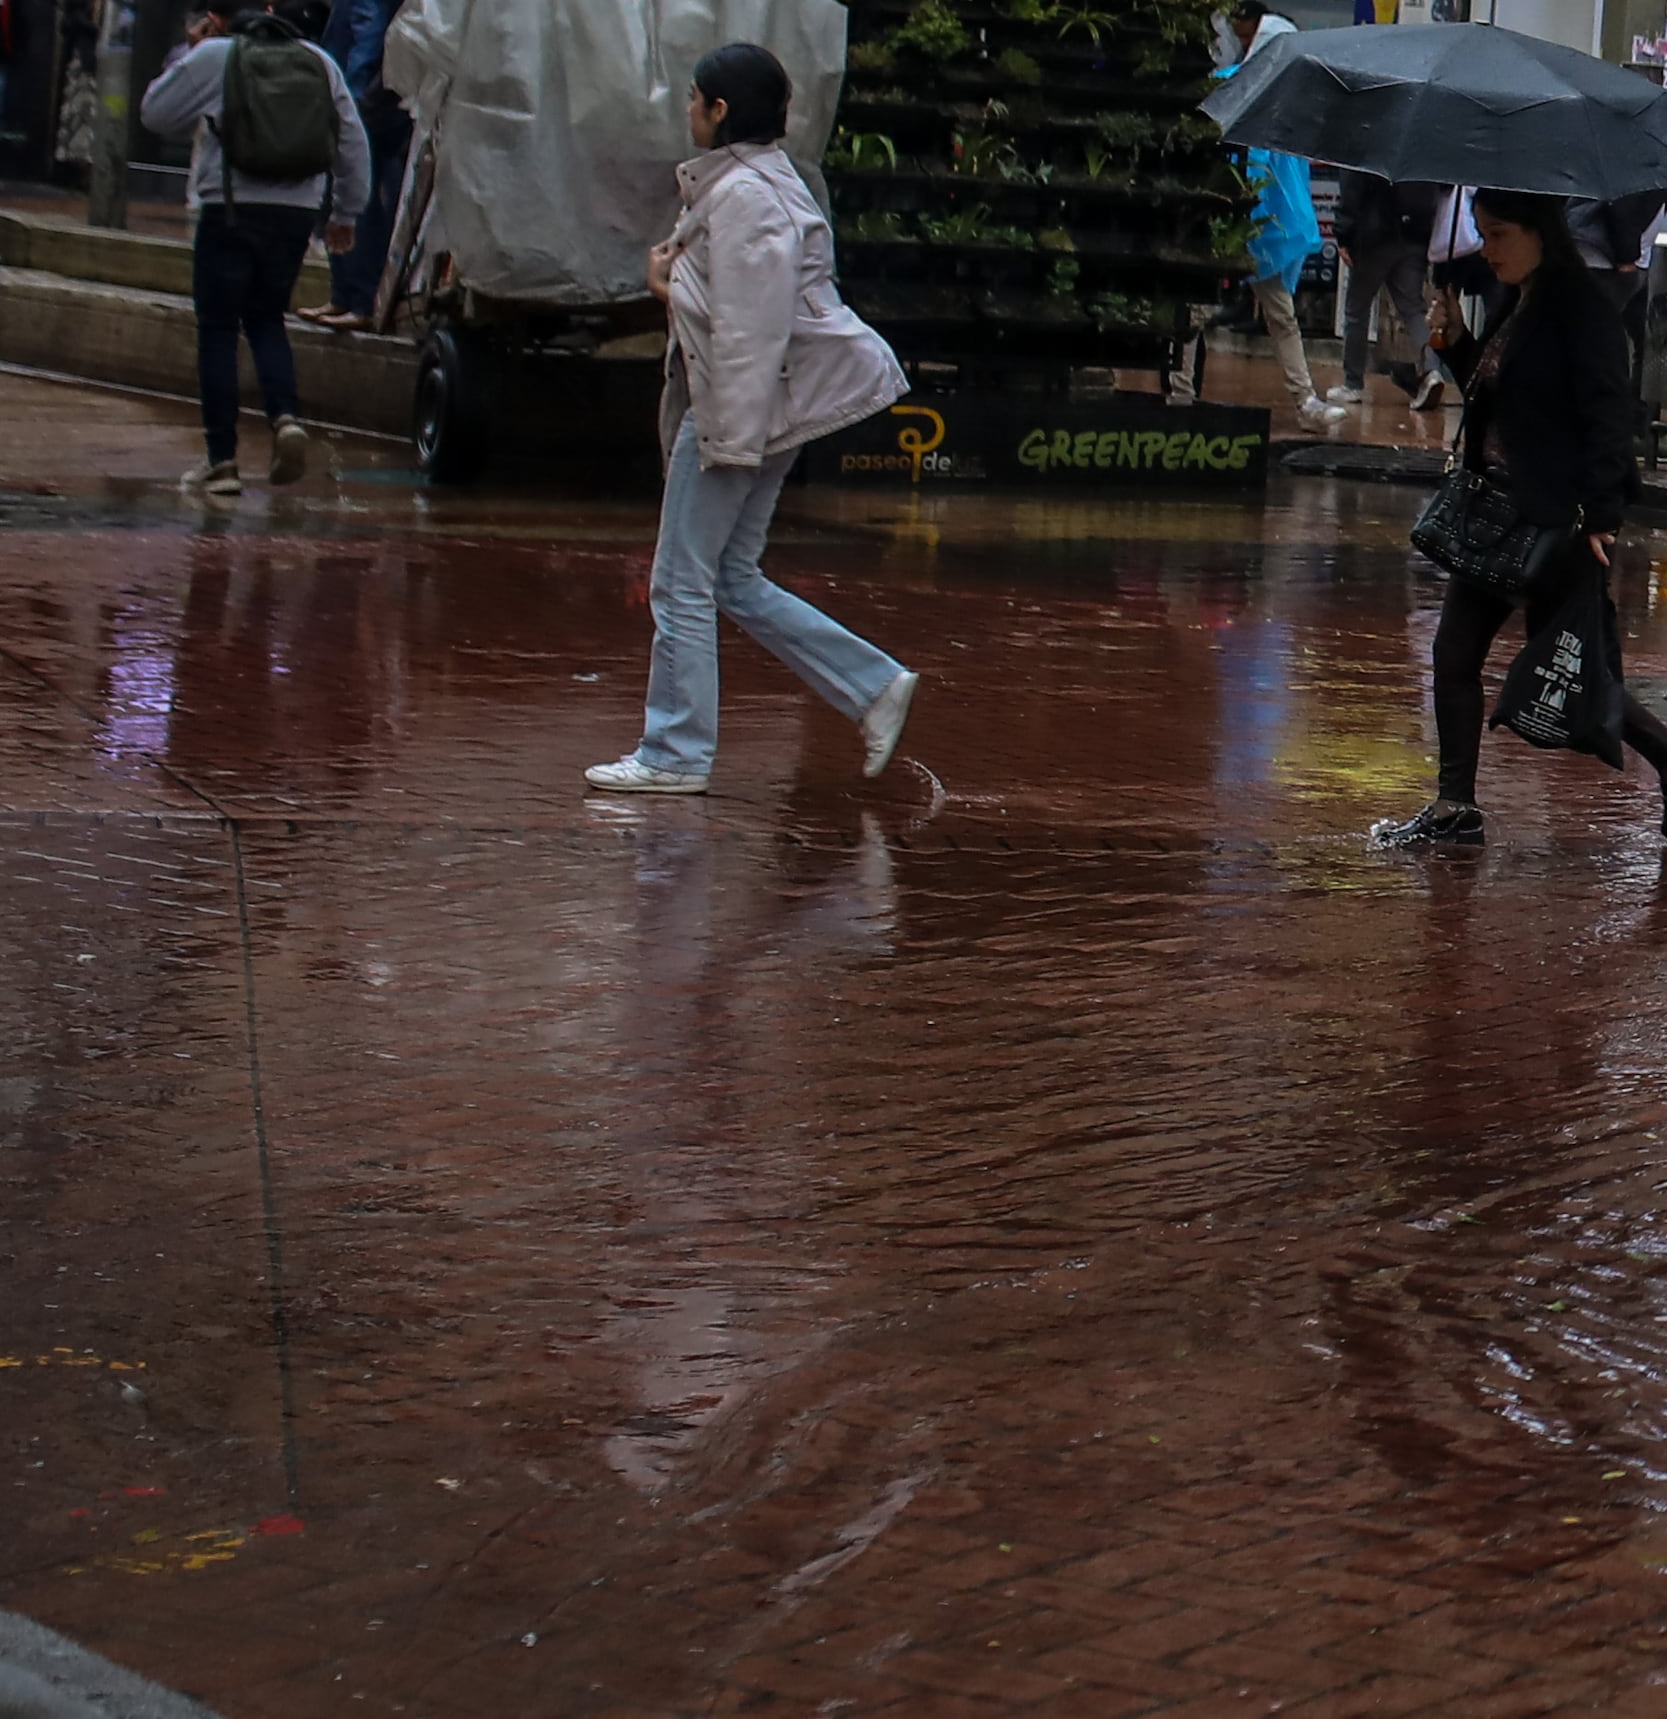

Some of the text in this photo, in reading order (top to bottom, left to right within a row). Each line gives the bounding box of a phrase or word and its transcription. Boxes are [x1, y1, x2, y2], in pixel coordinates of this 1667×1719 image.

[840, 453, 911, 473] paseo
[922, 451, 951, 471] de
[1017, 428, 1262, 473] GREENPEACE
